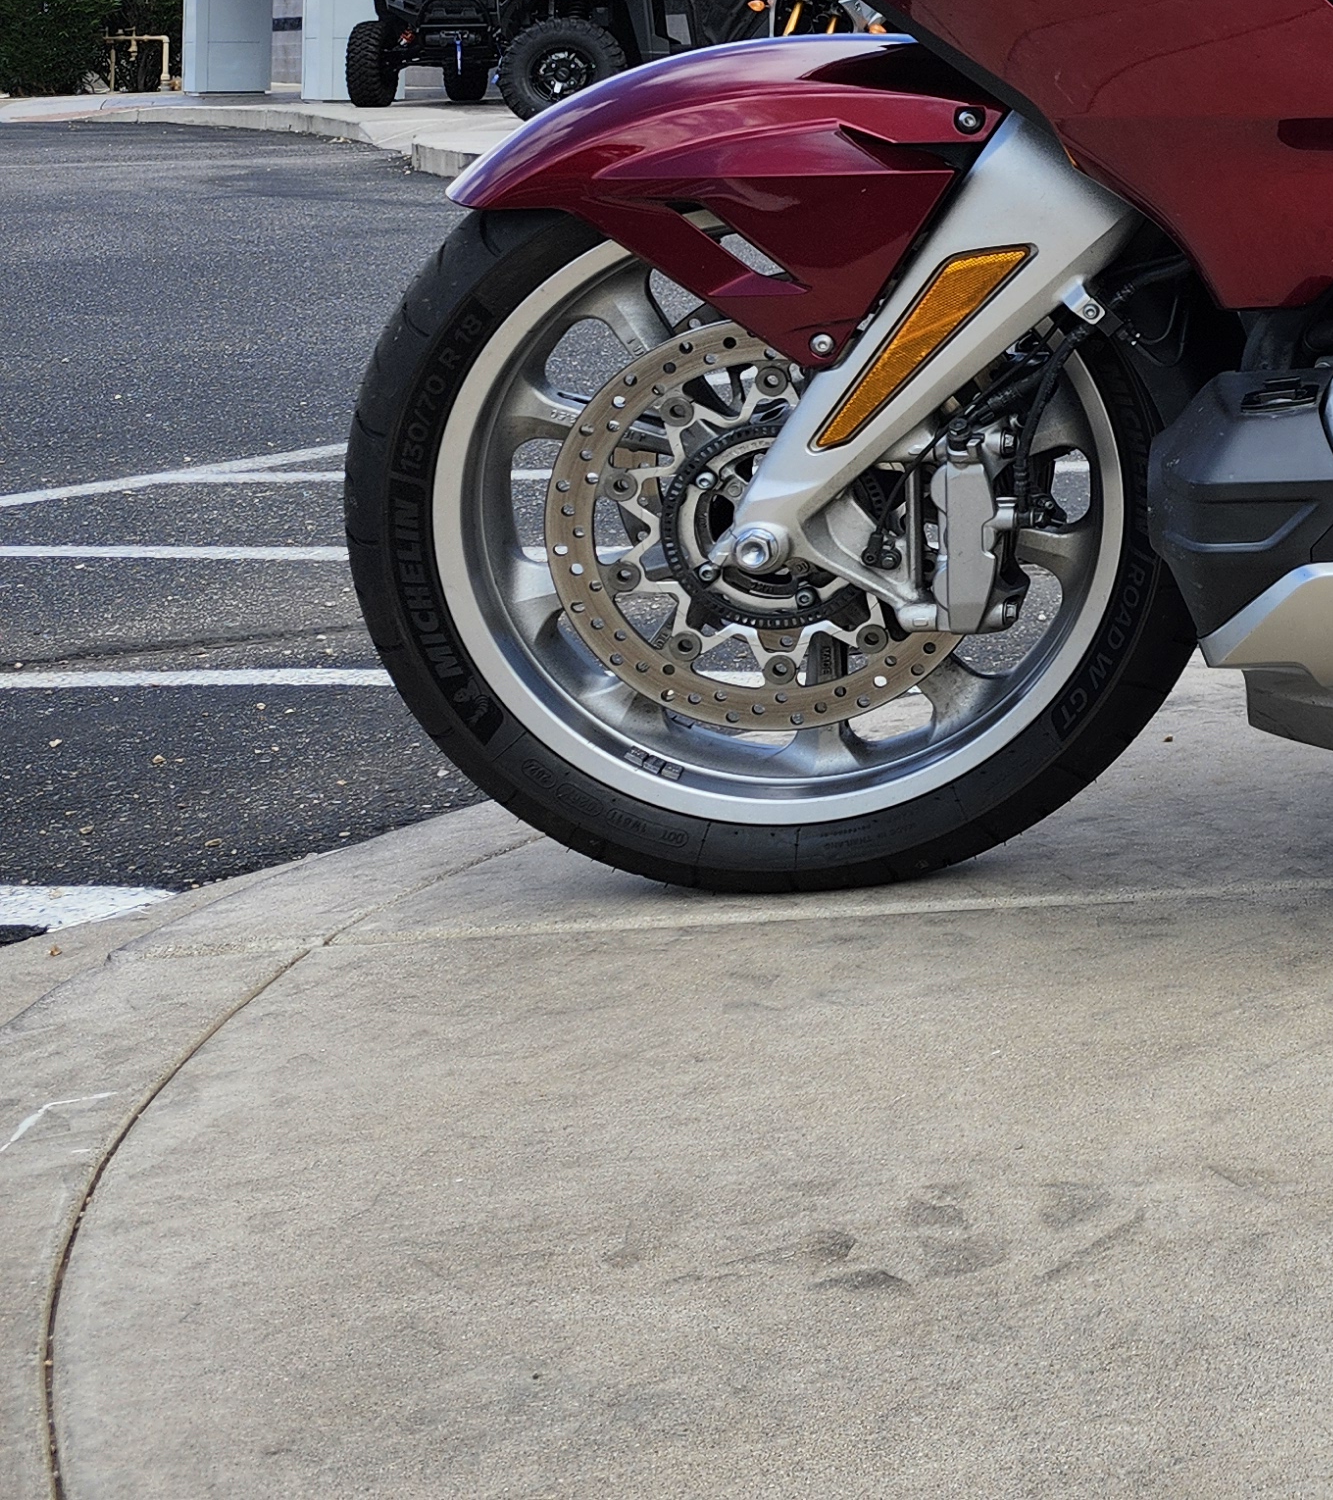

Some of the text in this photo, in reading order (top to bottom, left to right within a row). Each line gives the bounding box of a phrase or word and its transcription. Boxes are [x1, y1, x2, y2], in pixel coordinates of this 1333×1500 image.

[453, 313, 484, 345] 18
[400, 373, 447, 473] 130/70
[391, 497, 464, 681] MICHELIN
[1107, 562, 1146, 650] ROAD
[1060, 686, 1088, 731] GT
